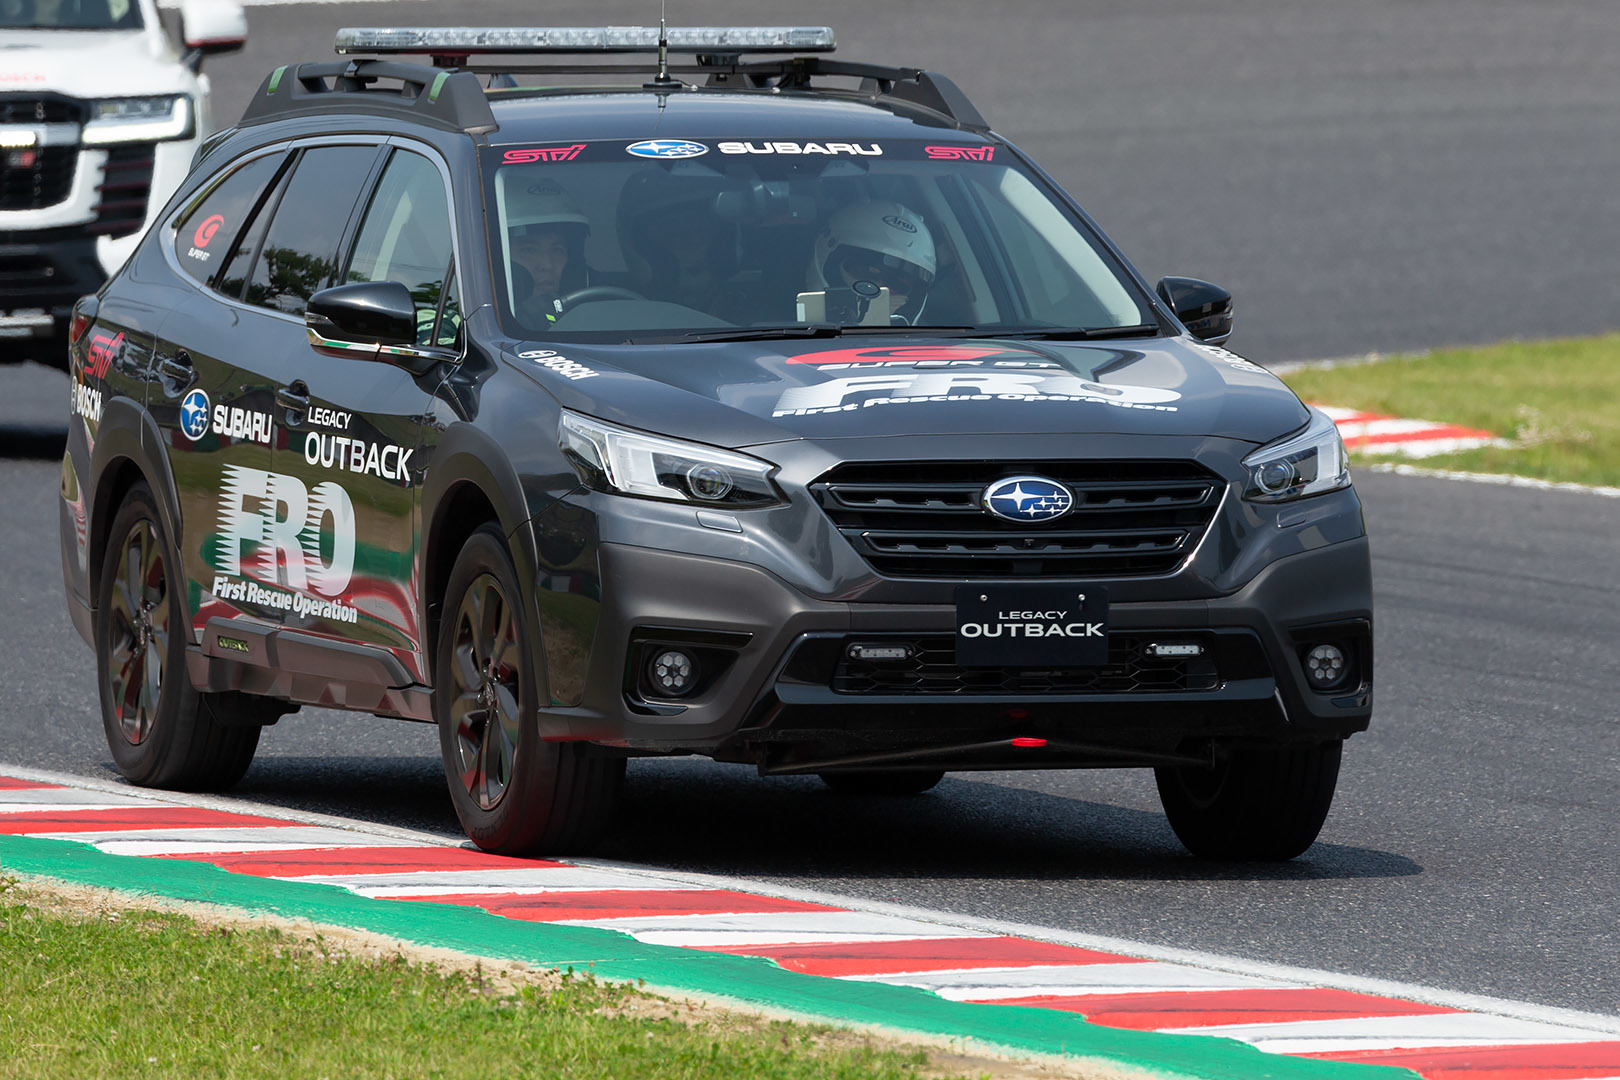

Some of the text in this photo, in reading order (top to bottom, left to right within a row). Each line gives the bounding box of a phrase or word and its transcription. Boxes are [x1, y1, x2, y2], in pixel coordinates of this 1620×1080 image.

[718, 141, 883, 157] SUBARU
[533, 355, 600, 381] BOSCH
[76, 383, 102, 422] BOSCH
[772, 393, 1178, 417] First Rescue Operation
[213, 404, 272, 443] SUBARU
[307, 406, 352, 430] LEGACY
[304, 431, 414, 481] OUTBACK
[214, 463, 356, 597] FRO
[212, 576, 358, 624] First Rescue Operation
[999, 611, 1068, 620] LEGACY
[960, 622, 1105, 638] OUTBACK
